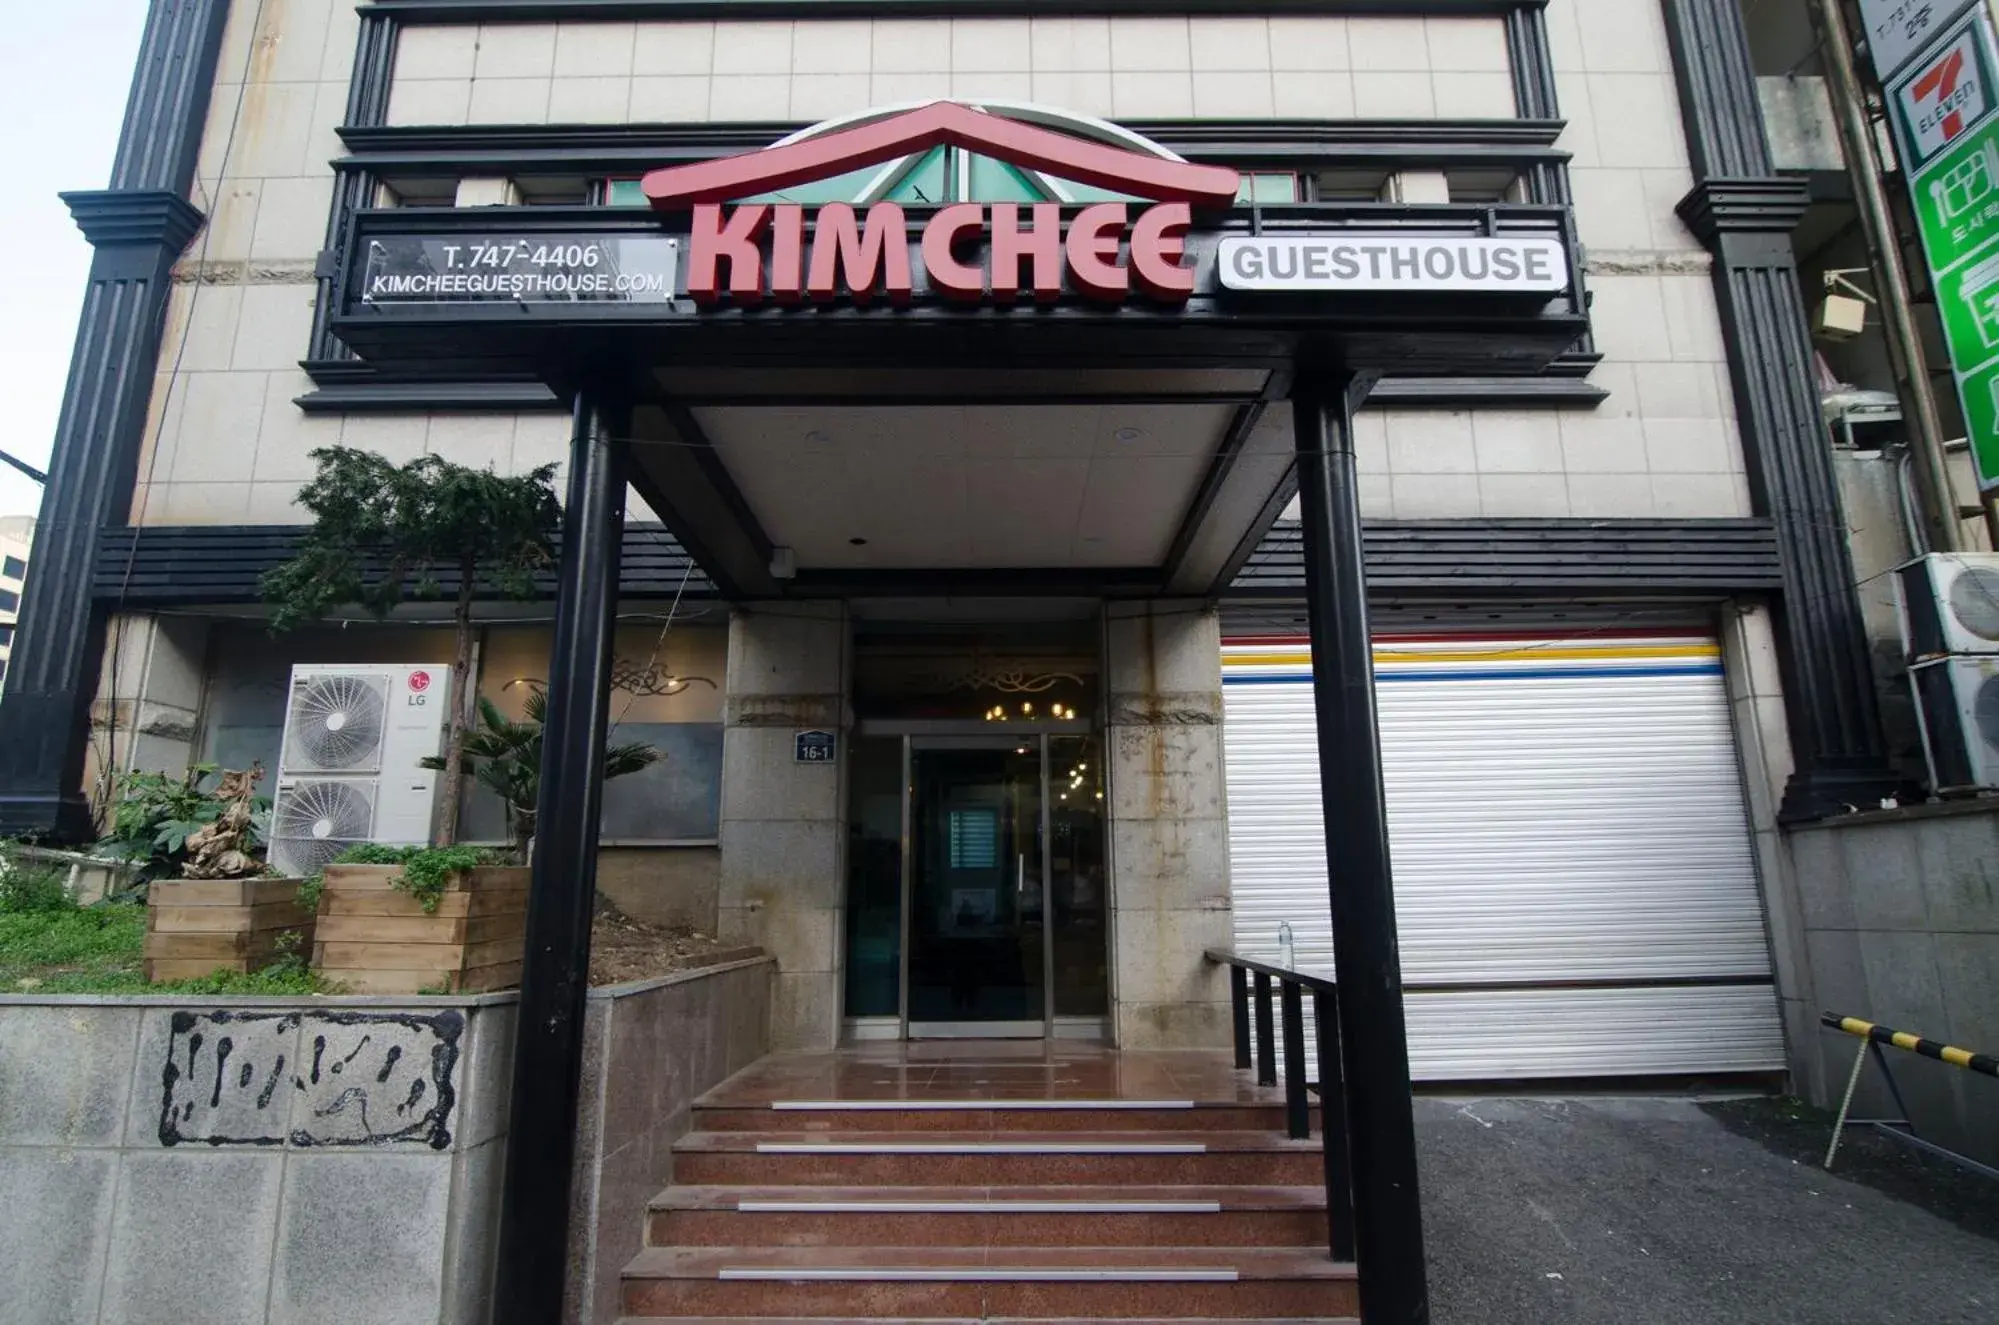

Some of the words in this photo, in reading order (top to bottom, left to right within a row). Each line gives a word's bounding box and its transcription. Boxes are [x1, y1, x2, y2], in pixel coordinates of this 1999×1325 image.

[686, 200, 1195, 300] KIMCHEE
[1232, 245, 1553, 281] GUESTHOUSE
[372, 274, 663, 293] KIMCHEEGUESTHOUSE.COM
[407, 694, 427, 706] LG
[802, 745, 829, 760] 16-1
